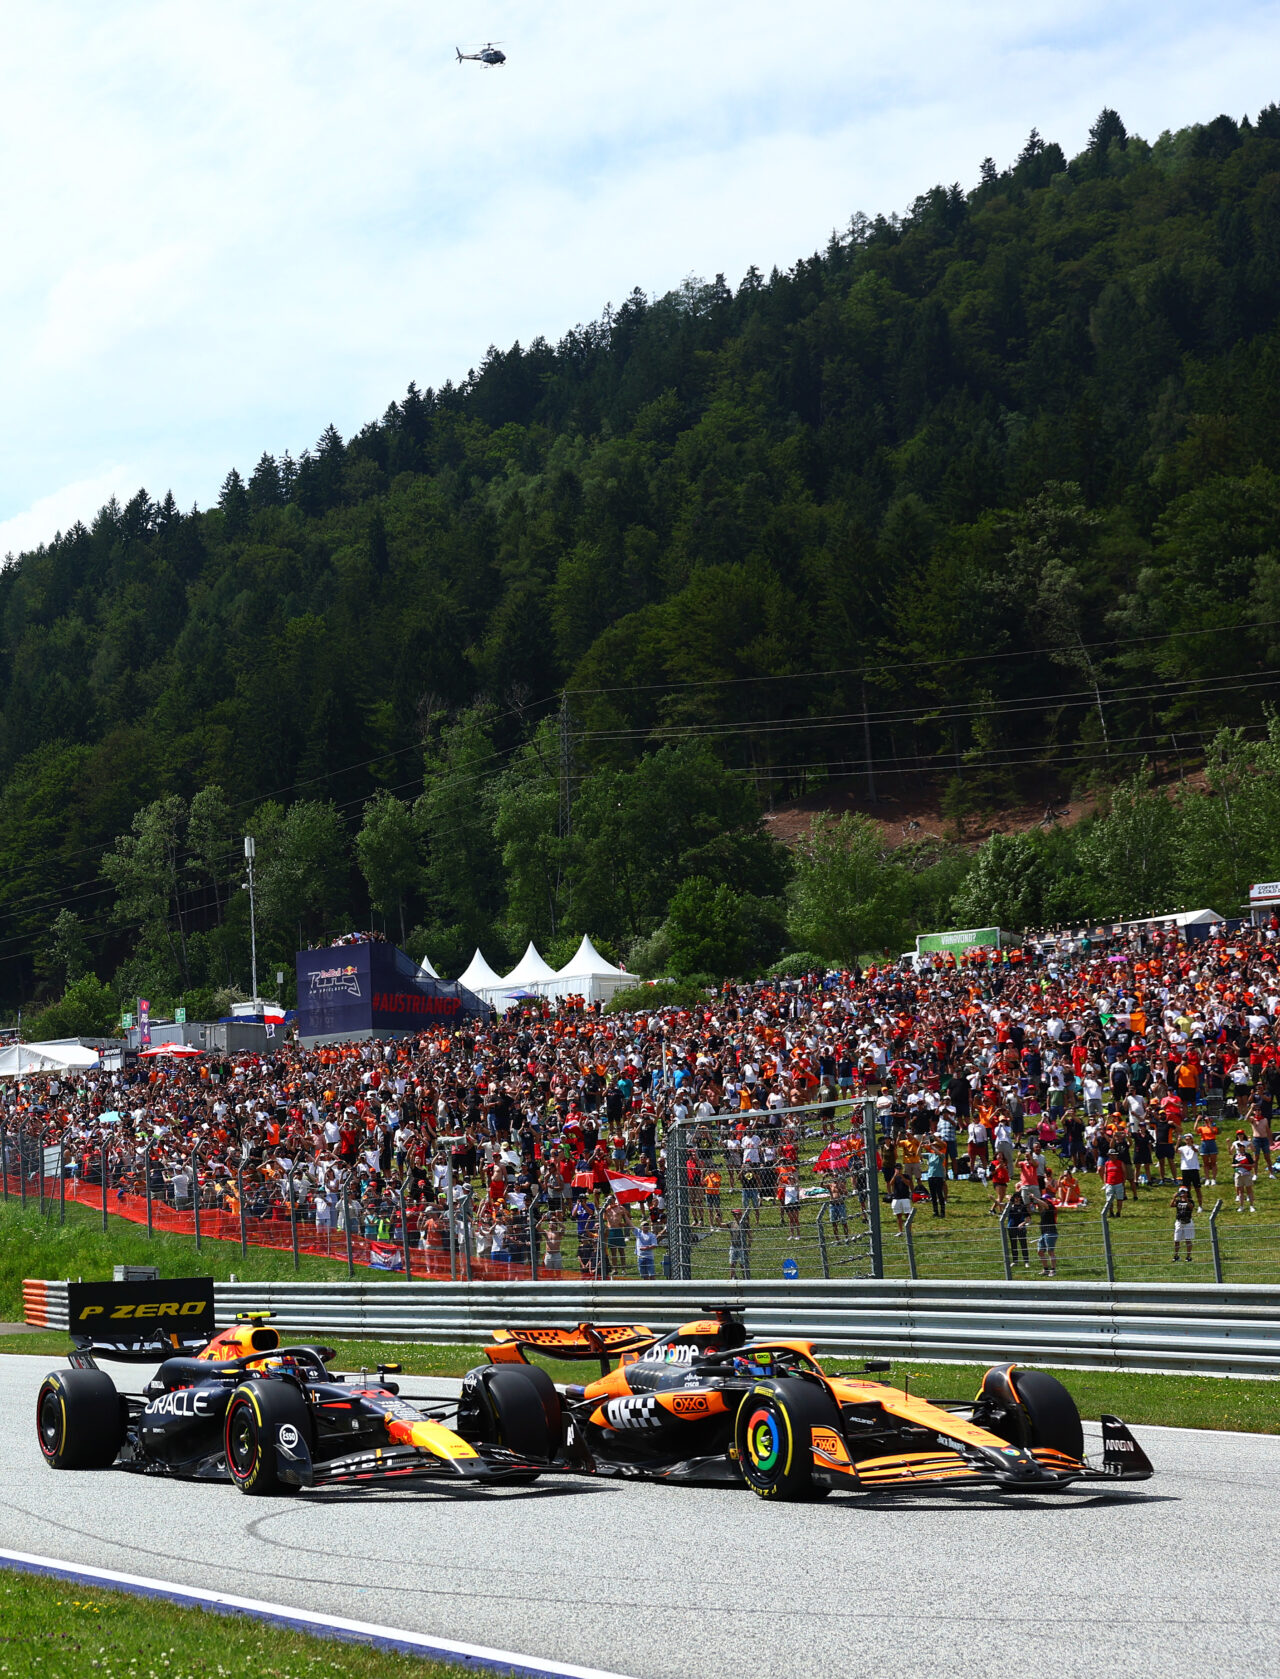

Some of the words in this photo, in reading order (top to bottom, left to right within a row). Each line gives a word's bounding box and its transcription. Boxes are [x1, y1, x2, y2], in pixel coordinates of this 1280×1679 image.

[372, 992, 461, 1016] #AUSTRIANGP
[79, 1306, 104, 1320] P
[110, 1301, 207, 1319] ZERO
[145, 1391, 215, 1417] ORACLE
[674, 1398, 707, 1410] OXXO
[282, 1430, 296, 1441] Esso
[814, 1439, 838, 1451] OXXO
